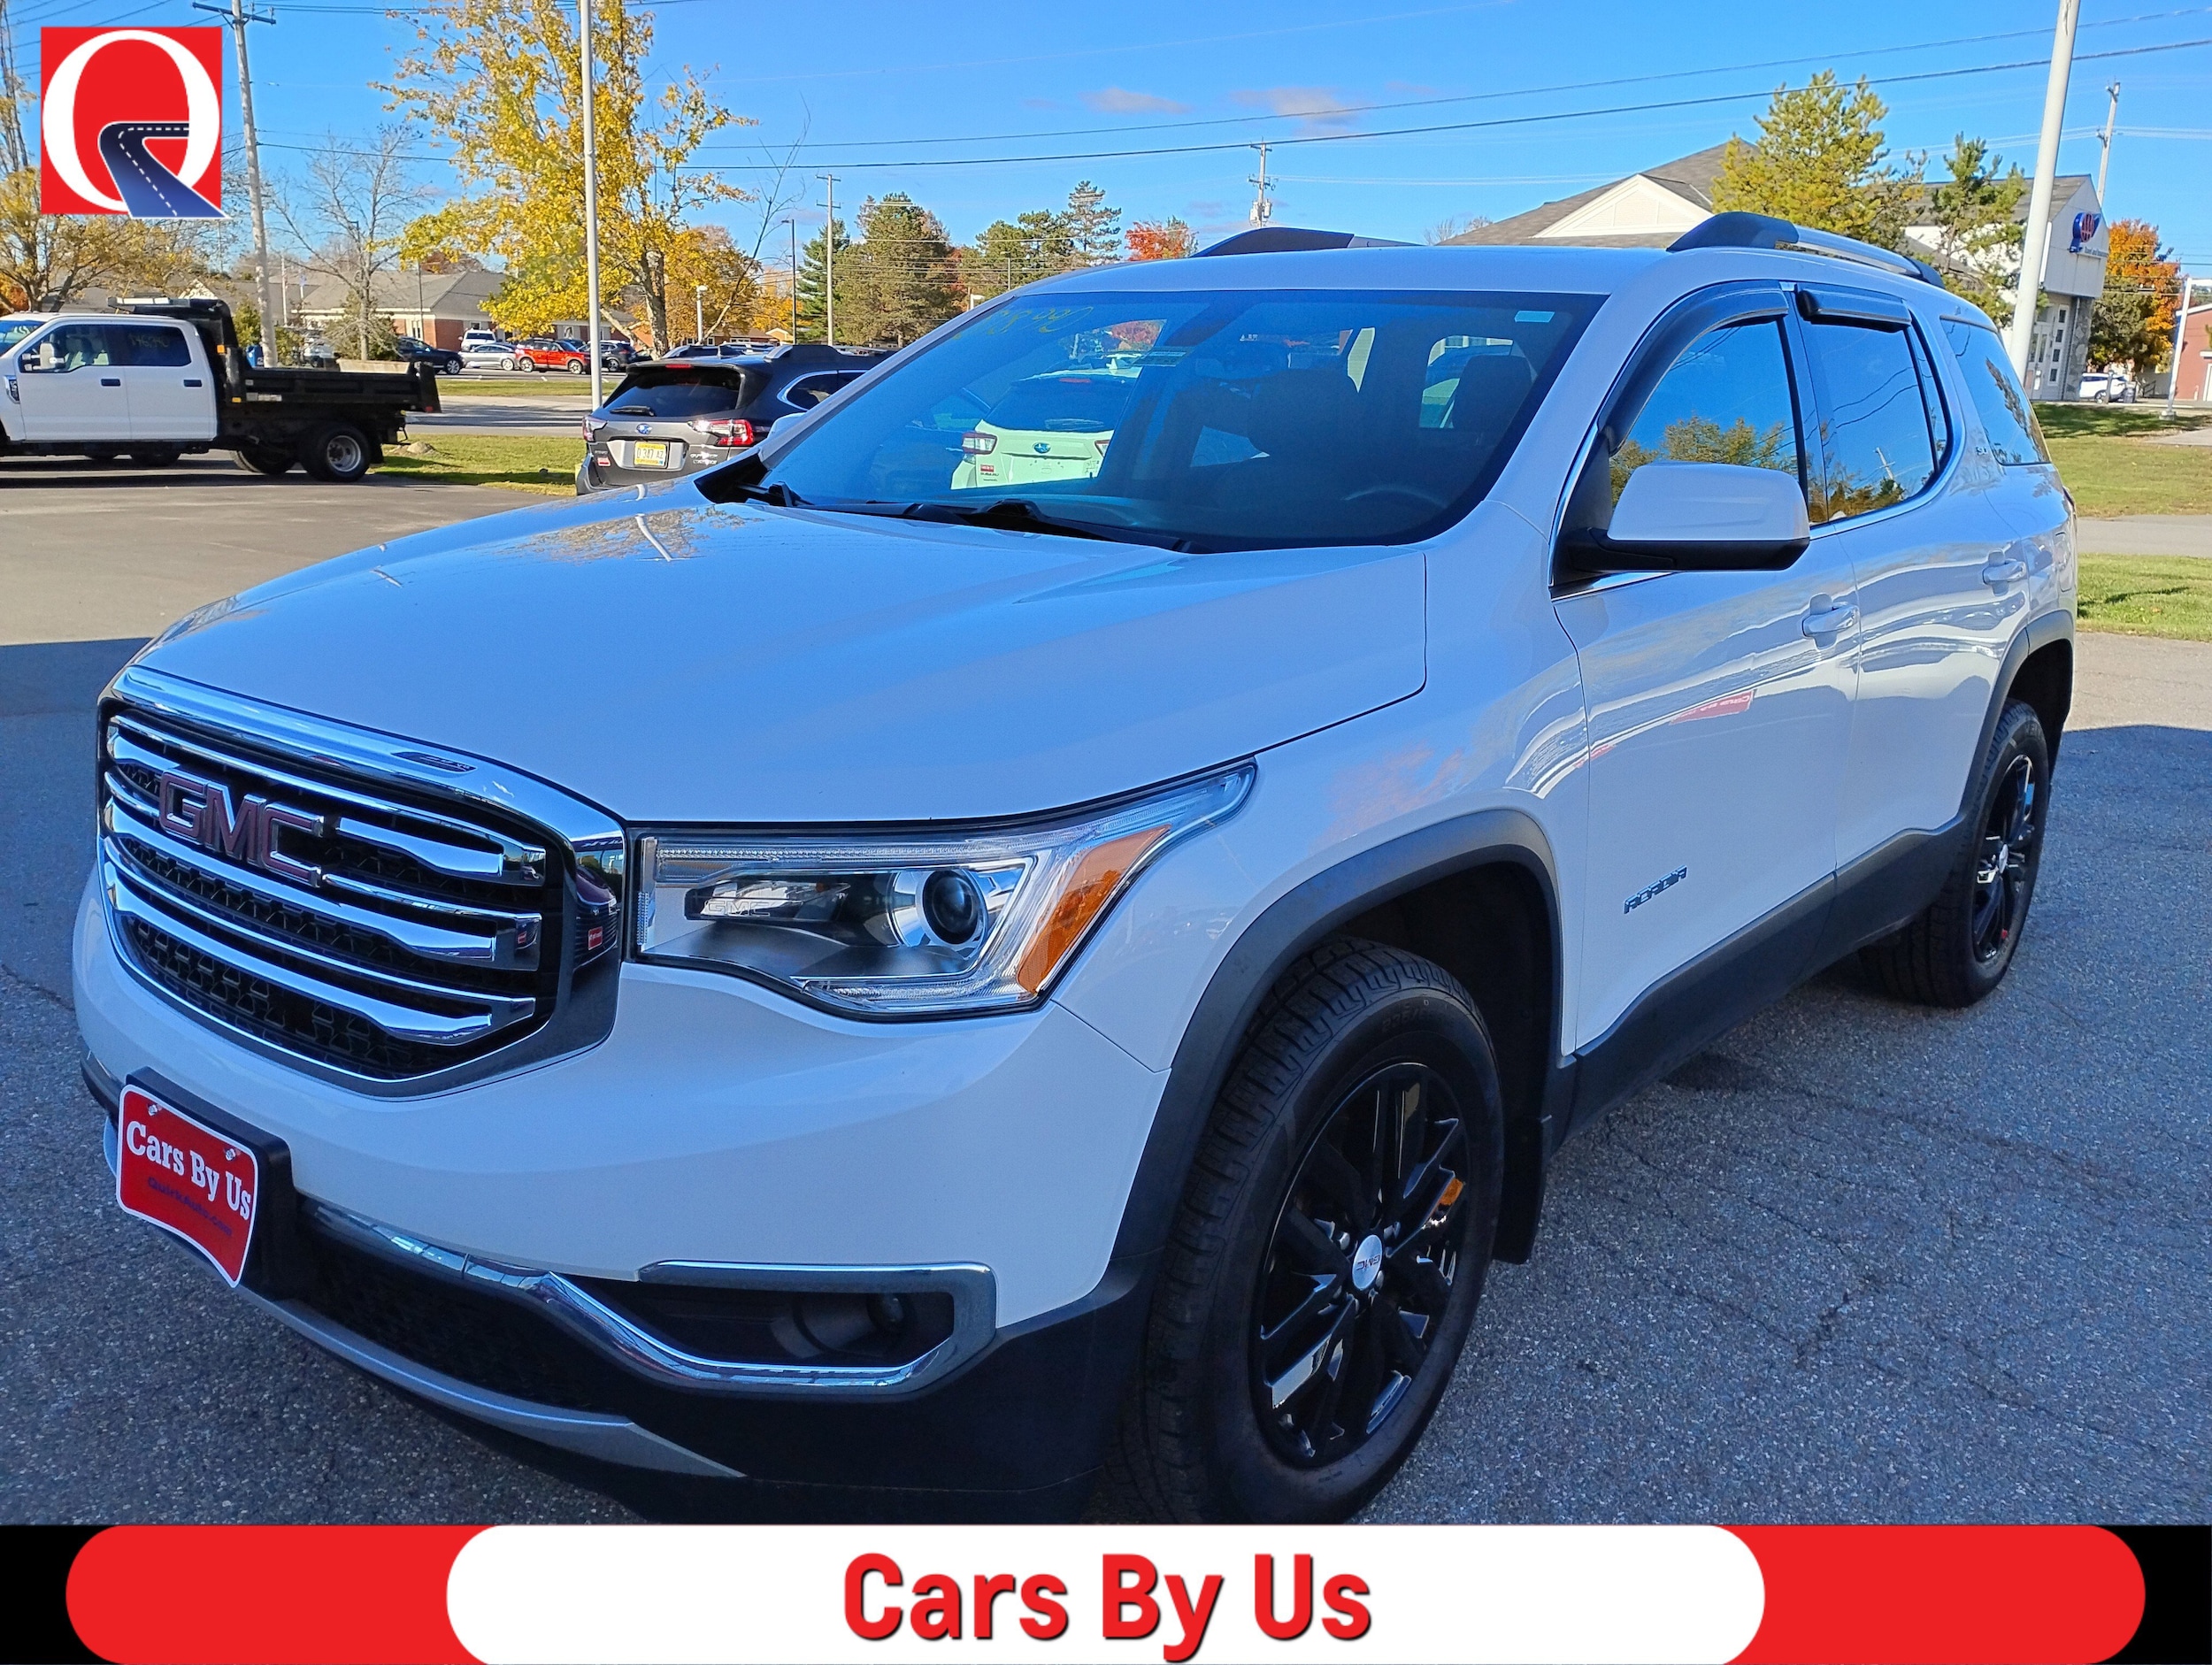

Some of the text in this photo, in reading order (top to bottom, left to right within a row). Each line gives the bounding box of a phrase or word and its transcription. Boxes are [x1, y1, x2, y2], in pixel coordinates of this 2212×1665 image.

[159, 768, 325, 887] GMC
[707, 900, 771, 917] GMC
[1624, 865, 1687, 915] ACADIA
[127, 1120, 251, 1221] Cars By Us
[1356, 1254, 1381, 1271] GMC
